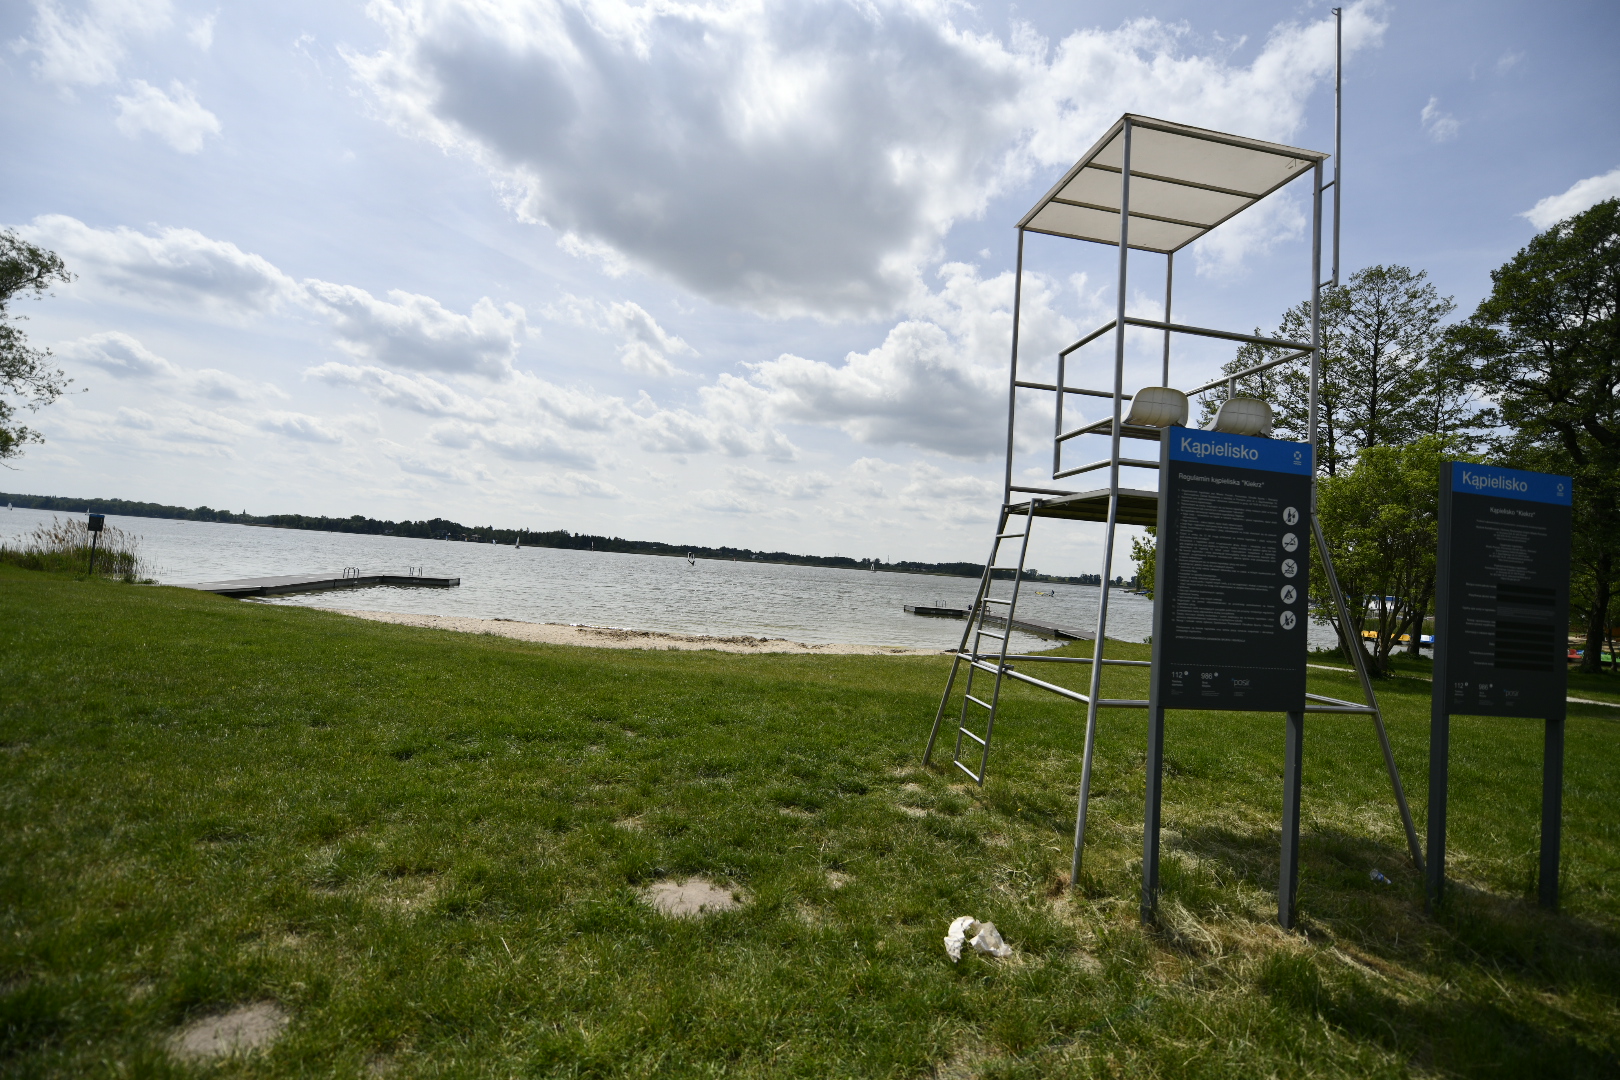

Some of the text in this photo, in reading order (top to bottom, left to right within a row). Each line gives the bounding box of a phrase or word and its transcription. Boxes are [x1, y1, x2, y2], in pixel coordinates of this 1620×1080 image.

[1181, 437, 1259, 460] Kąpielisko
[1178, 472, 1210, 483] Regulamin
[1211, 476, 1241, 486] kąpieliska
[1462, 471, 1528, 492] Kąpielisko
[1171, 671, 1183, 679] 112
